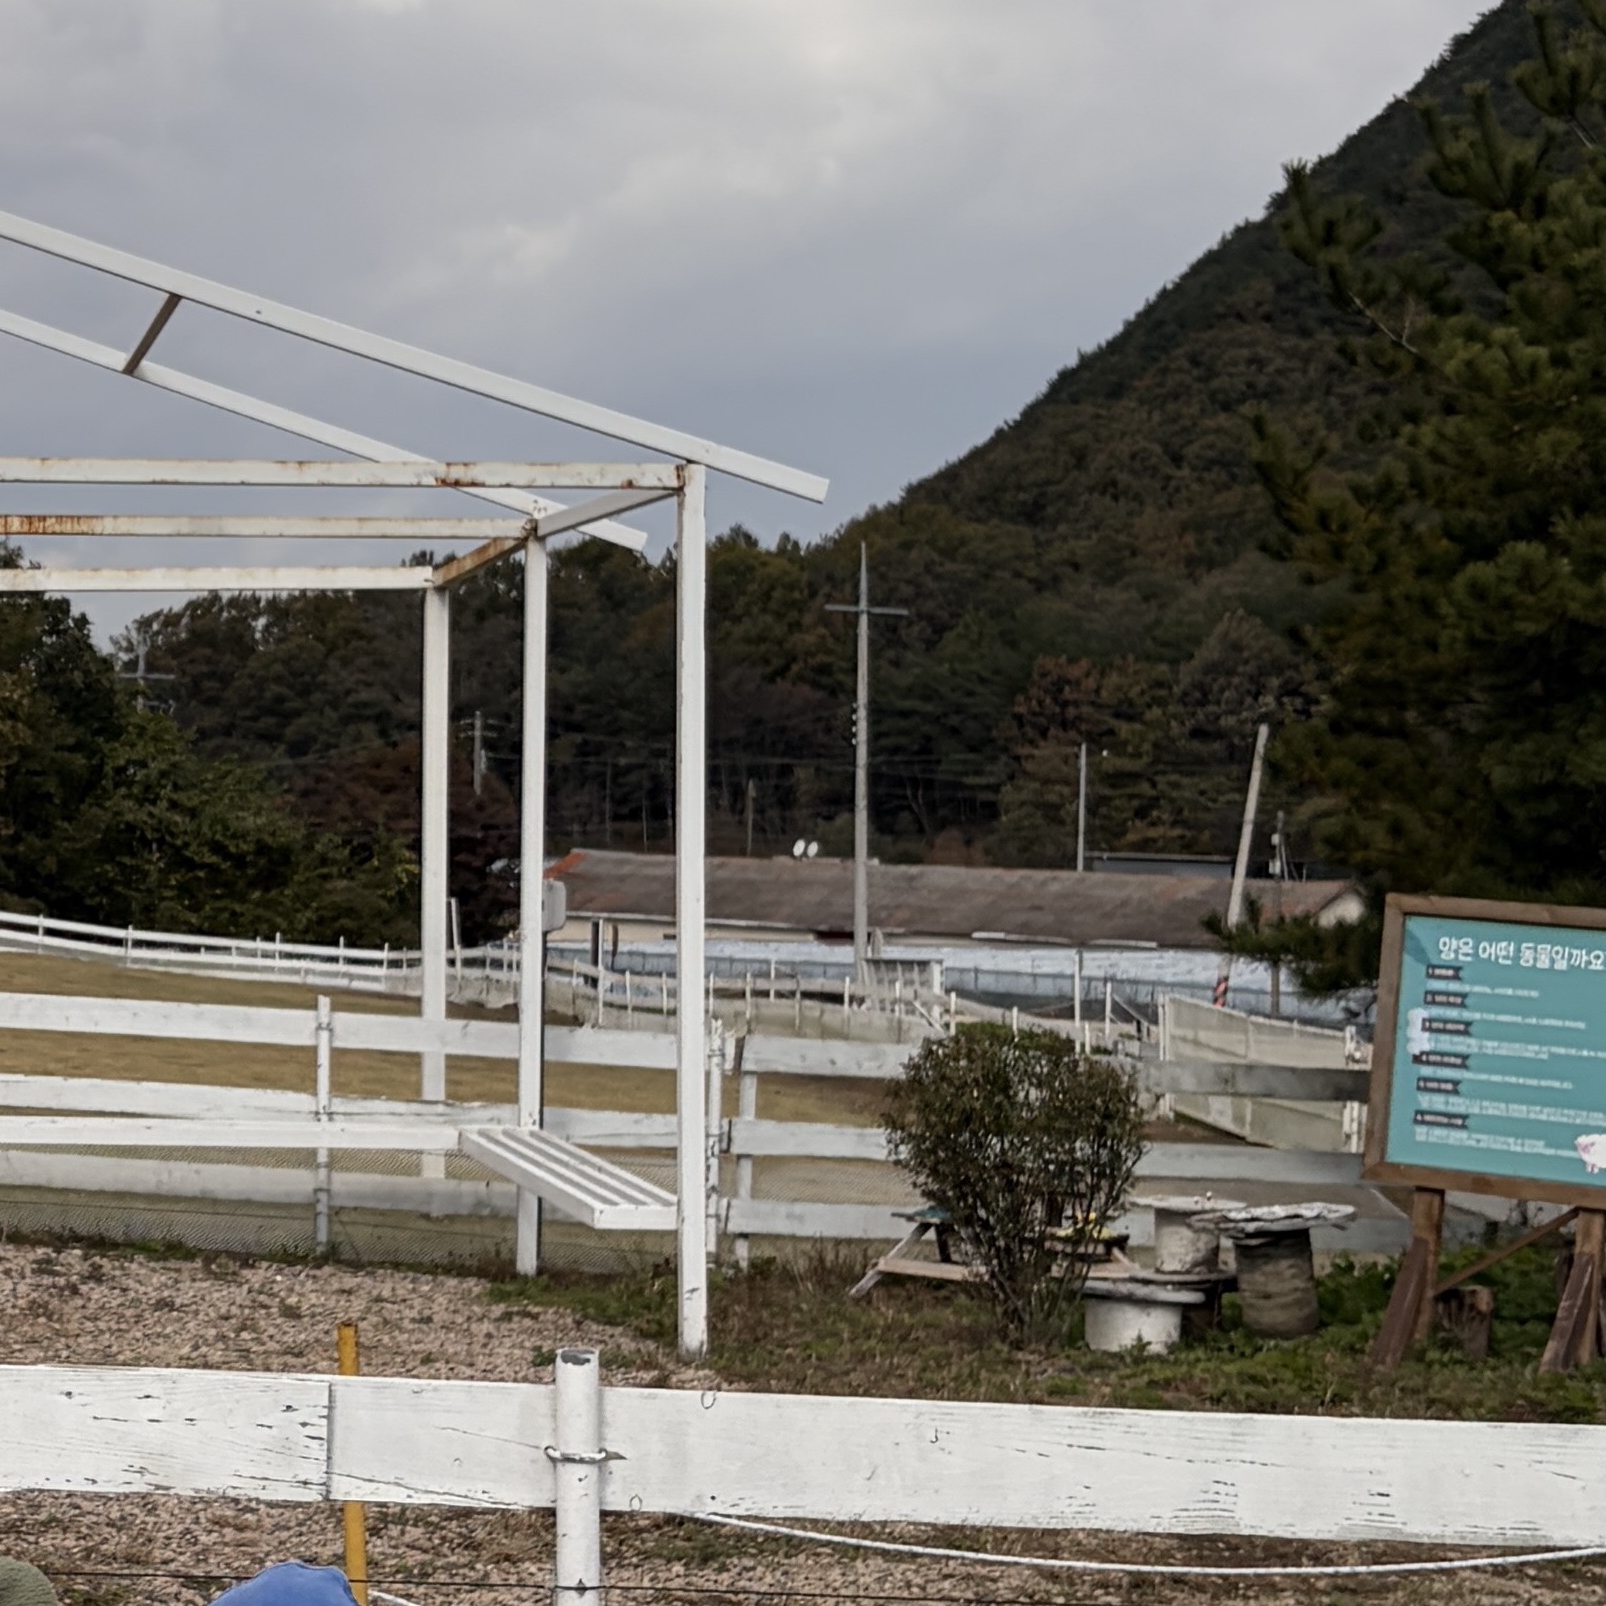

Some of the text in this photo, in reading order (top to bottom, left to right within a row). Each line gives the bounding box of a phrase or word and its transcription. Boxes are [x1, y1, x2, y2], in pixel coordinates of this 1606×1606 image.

[1438, 936, 1605, 971] 양은 어떤 동물일까요
